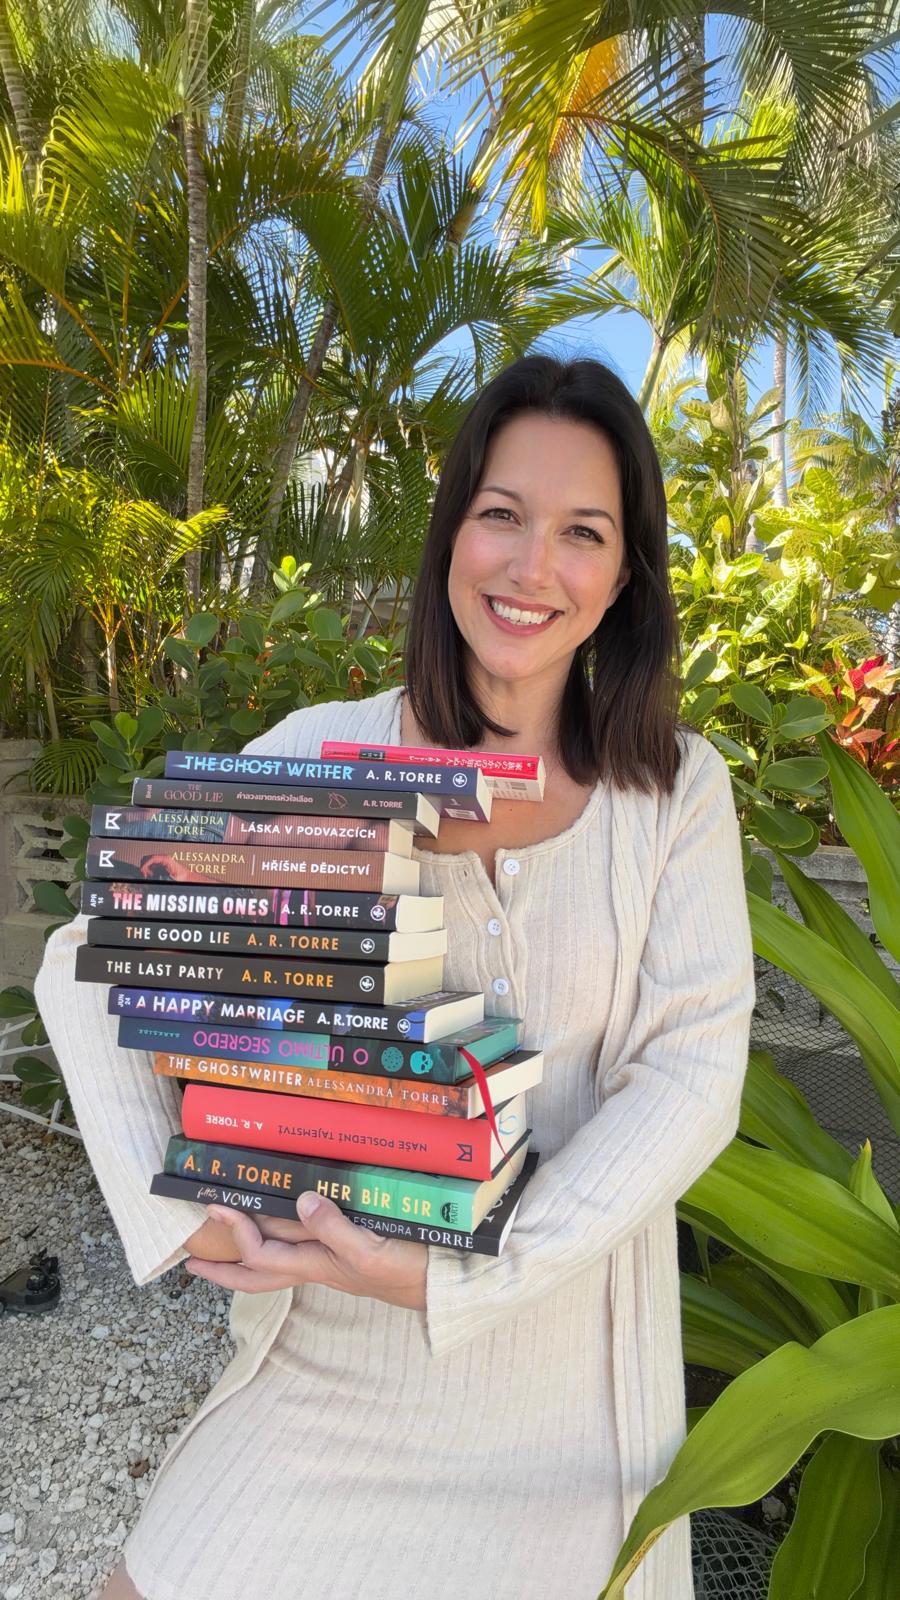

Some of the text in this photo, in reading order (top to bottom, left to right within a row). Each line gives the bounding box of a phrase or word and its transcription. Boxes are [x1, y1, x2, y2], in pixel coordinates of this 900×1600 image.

[184, 755, 353, 781] THE GHOST WRITER
[366, 769, 442, 784] A. R. TORRE
[164, 790, 224, 803] GOOD LIE
[380, 800, 403, 809] TORRE
[150, 813, 224, 826] ALESSANDRA
[167, 825, 206, 836] TORRE
[241, 822, 377, 839] LÁSKA V PODVAZCÍCH
[172, 852, 245, 864] ALESSANDRA
[189, 864, 227, 875] TORRE
[262, 860, 372, 876] HŘÍŠNÉ DĚDICTVÍ
[90, 893, 98, 908] APR
[112, 893, 269, 916] THE MISSING ONES
[281, 904, 359, 917] A. R. TORRE
[126, 926, 230, 944] THE GOOD LIE
[247, 933, 339, 950] A. R. TORRE
[106, 960, 224, 980] THE LAST PARTY
[241, 969, 334, 987] A. R. TORRE
[117, 993, 125, 1008] JUN
[125, 997, 131, 1006] 24
[135, 995, 305, 1024] A HAPPY MARRIAGE
[346, 1014, 388, 1030] TORRE
[193, 1030, 369, 1067] O ÚLTIMO SEGREDO
[168, 1055, 449, 1106] THE GHOSTWRITER ALESSANDRA TORRE
[205, 1114, 264, 1131] A. R. TORRE
[278, 1124, 427, 1152] NAŠE POSLEDNÍ TAJEMSTVÍ
[183, 1154, 292, 1190] A. R. TORRE
[222, 1190, 262, 1210] VOWS
[317, 1179, 431, 1217] HER BİR SIR
[347, 1215, 474, 1249] ESSANDRA TORRE
